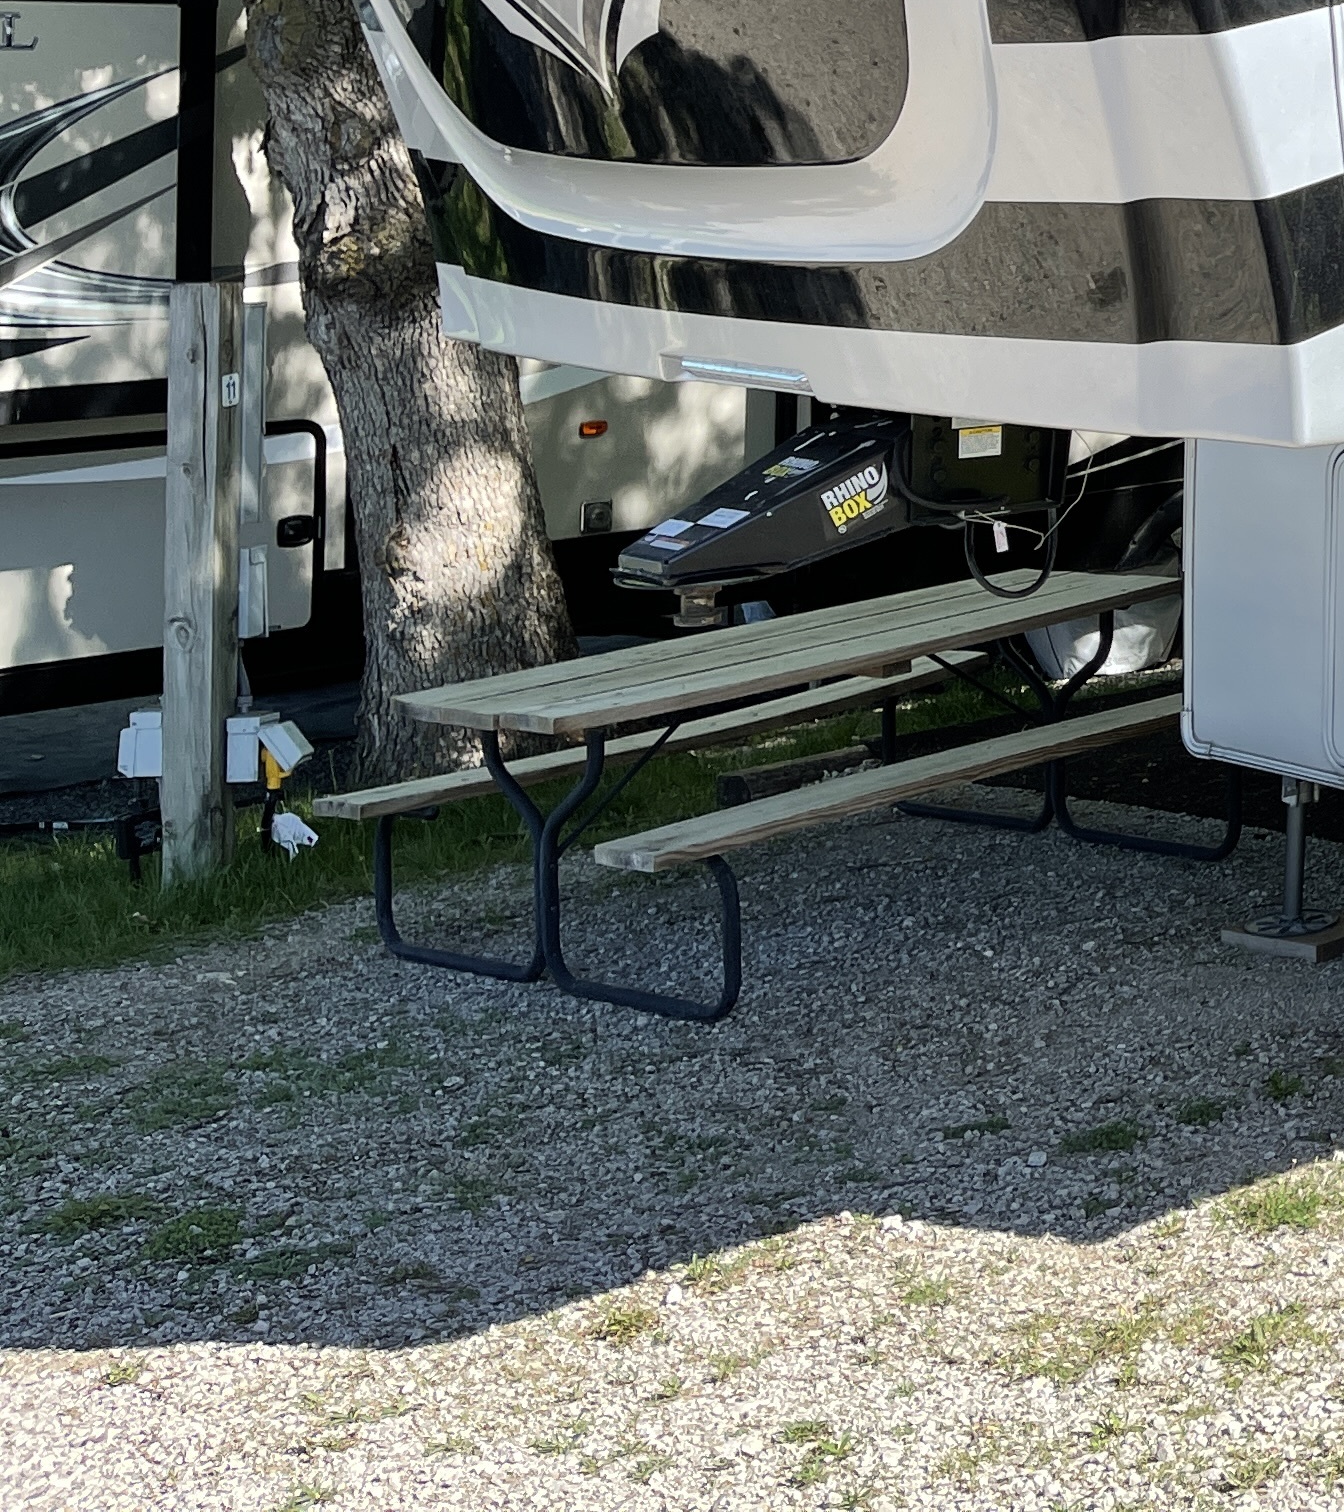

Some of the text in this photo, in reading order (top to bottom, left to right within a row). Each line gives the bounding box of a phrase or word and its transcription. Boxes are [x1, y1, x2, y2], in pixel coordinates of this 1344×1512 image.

[226, 380, 236, 399] 11
[820, 466, 880, 511] RHINO
[829, 490, 873, 527] BOX
